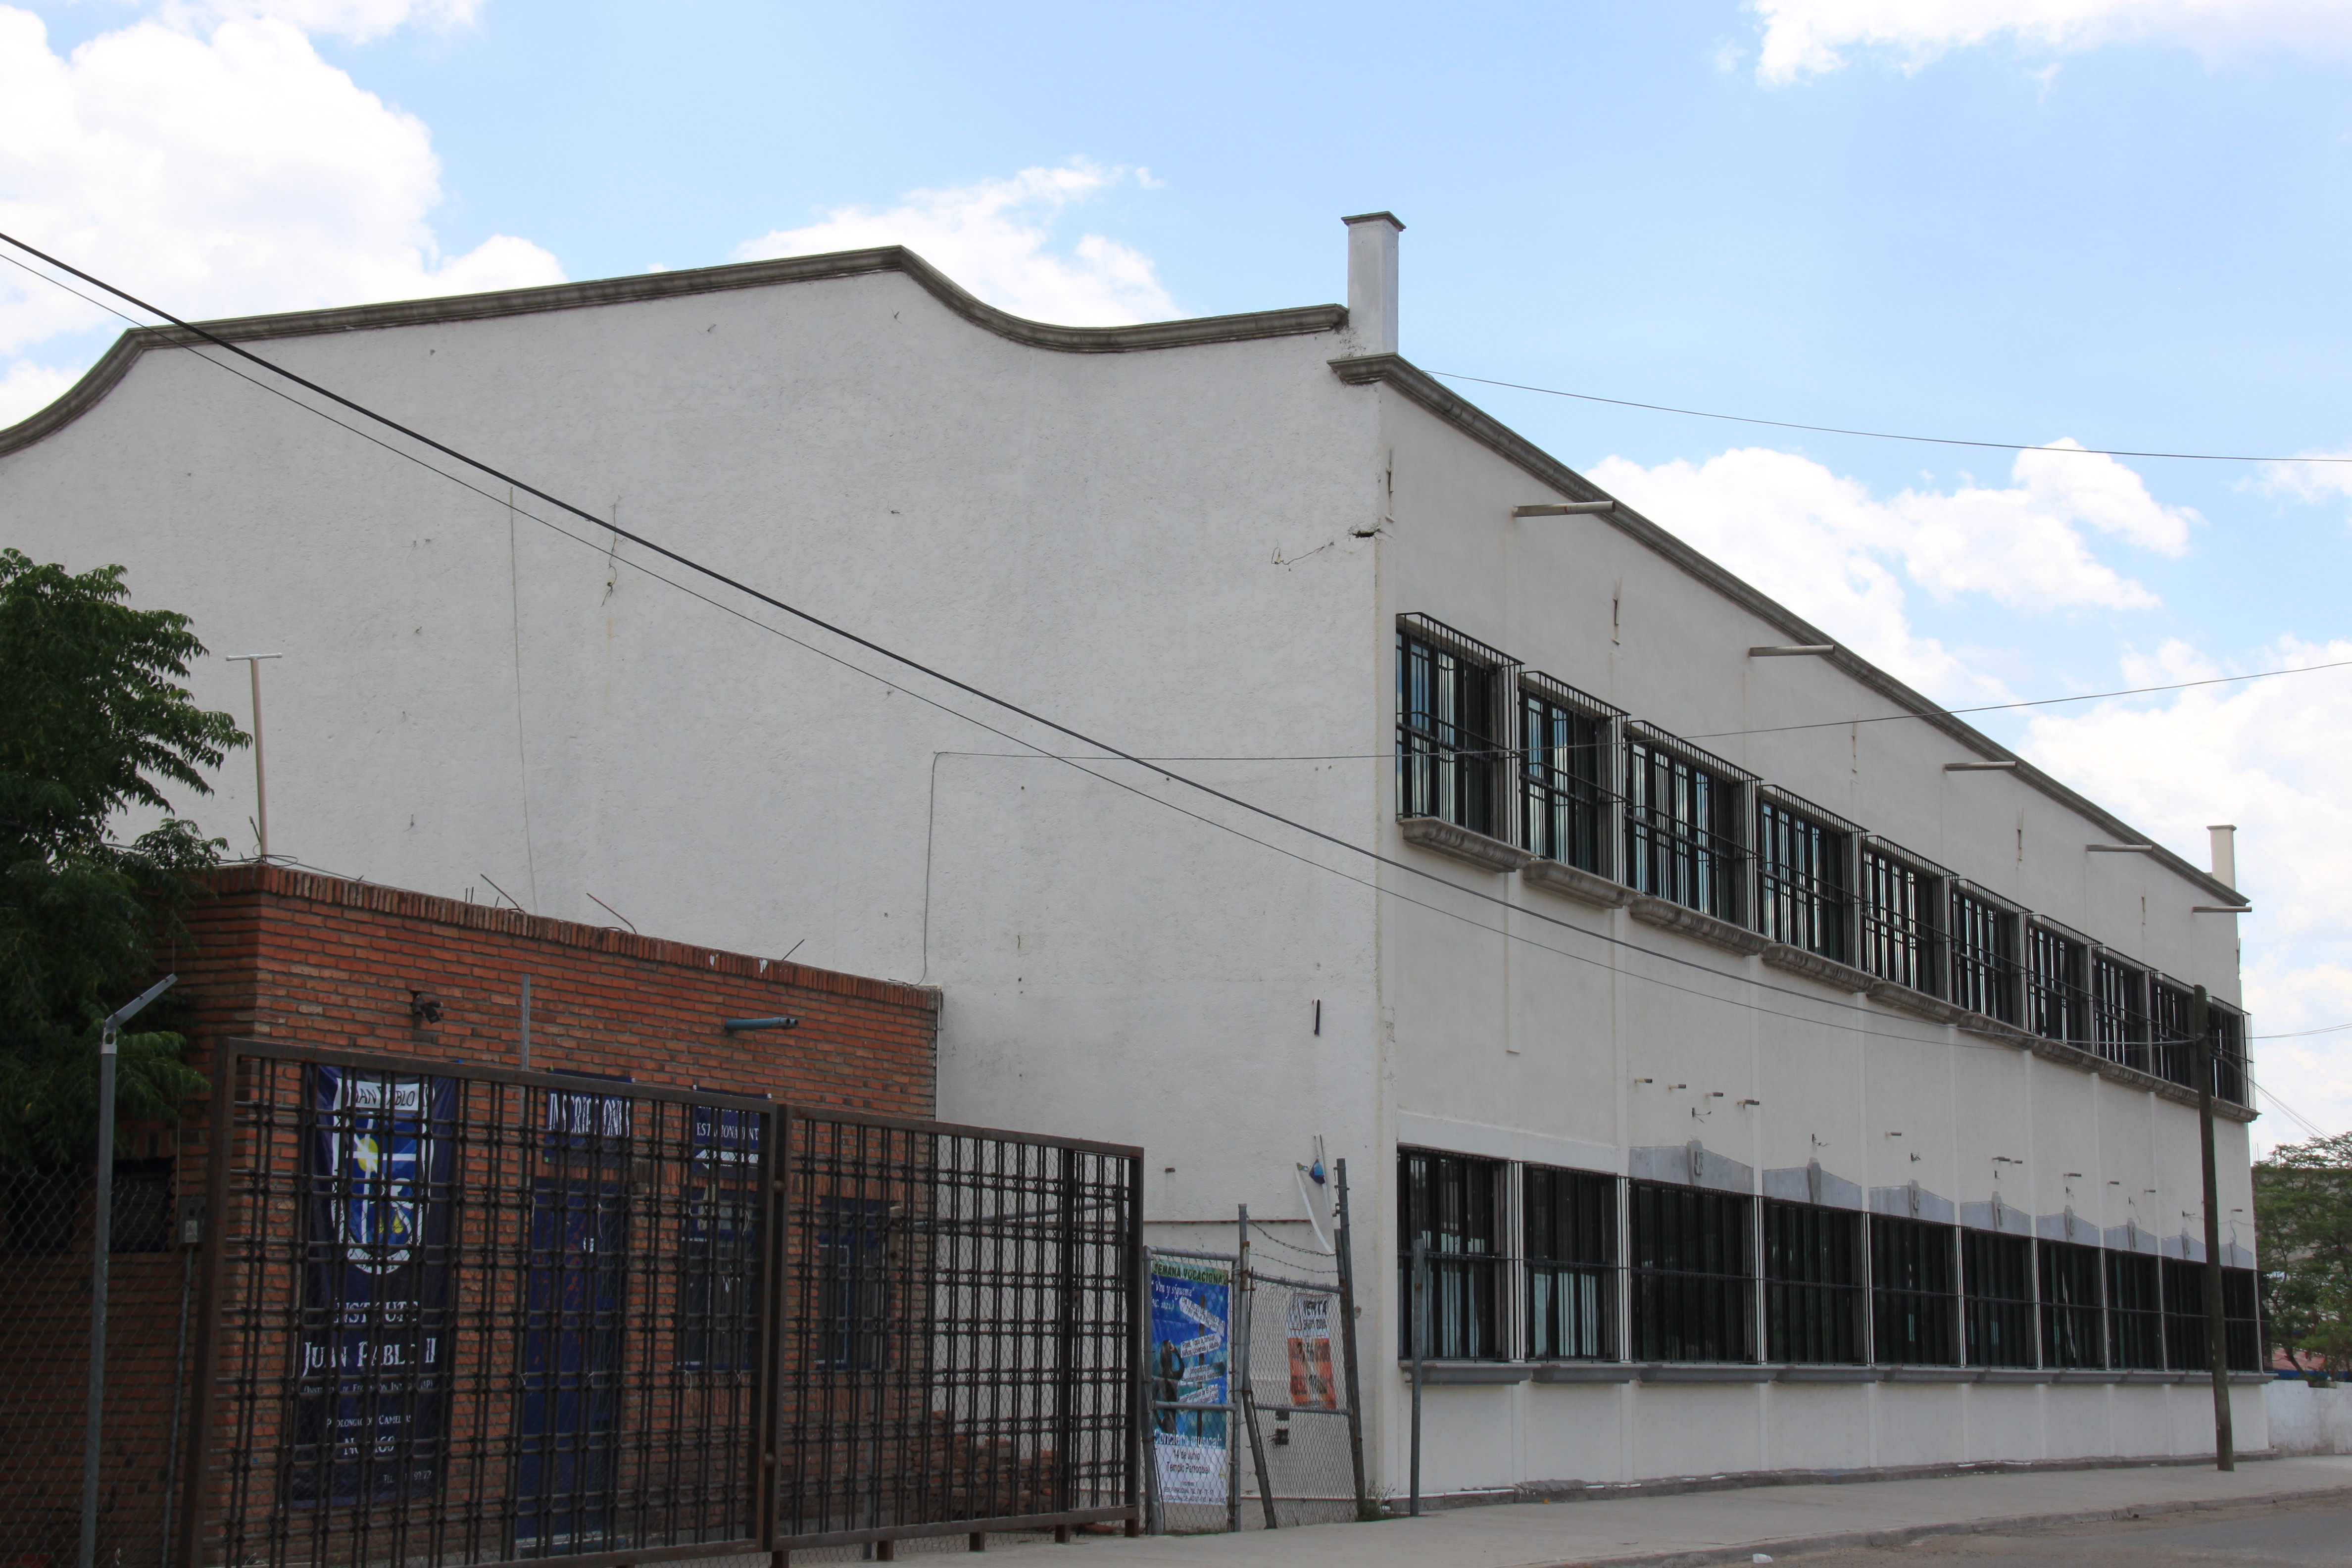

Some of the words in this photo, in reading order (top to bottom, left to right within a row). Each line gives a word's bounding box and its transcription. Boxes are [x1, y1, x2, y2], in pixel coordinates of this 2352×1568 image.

[1154, 1263, 1181, 1278] SEMANA
[1183, 1268, 1227, 1285] VOCACIONAL
[1154, 1428, 1189, 1446] Concierto
[1174, 1449, 1179, 1458] 14
[1181, 1449, 1187, 1459] de
[1167, 1461, 1184, 1473] Templo
